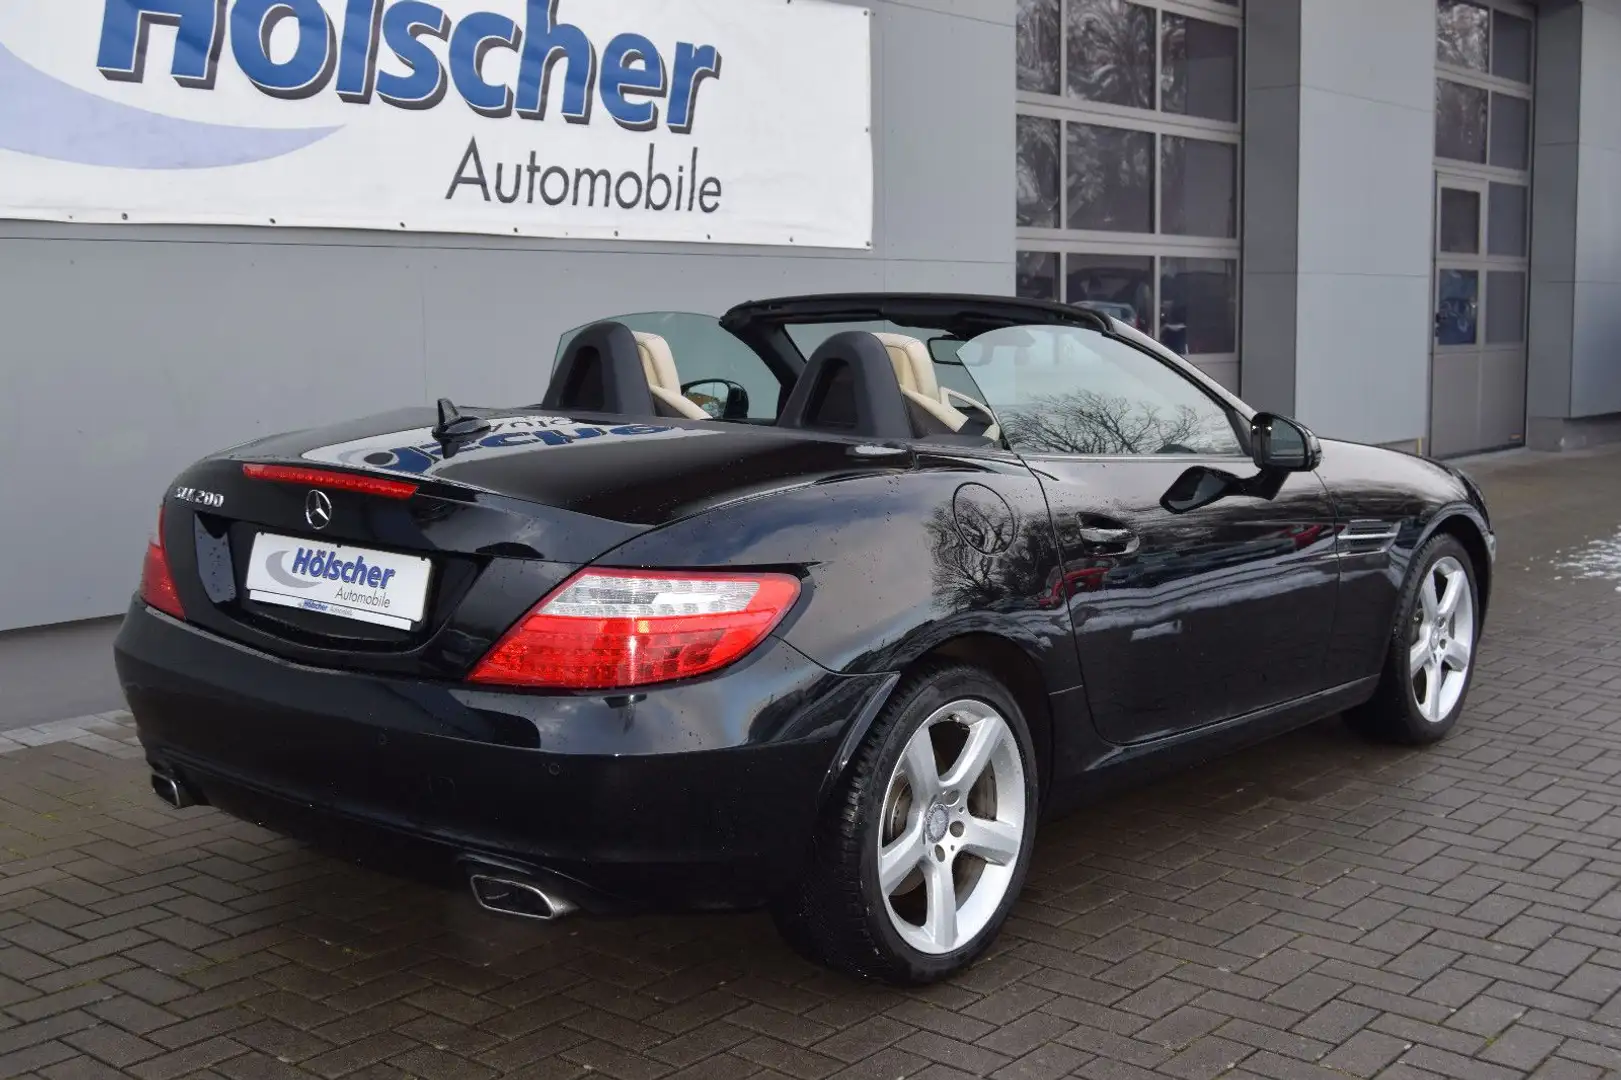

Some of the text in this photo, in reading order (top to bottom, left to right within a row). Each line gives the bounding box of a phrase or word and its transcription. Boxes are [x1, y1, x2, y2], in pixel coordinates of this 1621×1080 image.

[445, 136, 722, 213] Automobile
[195, 490, 225, 507] 200
[292, 547, 396, 589] Hölscher
[335, 587, 391, 608] Automobile
